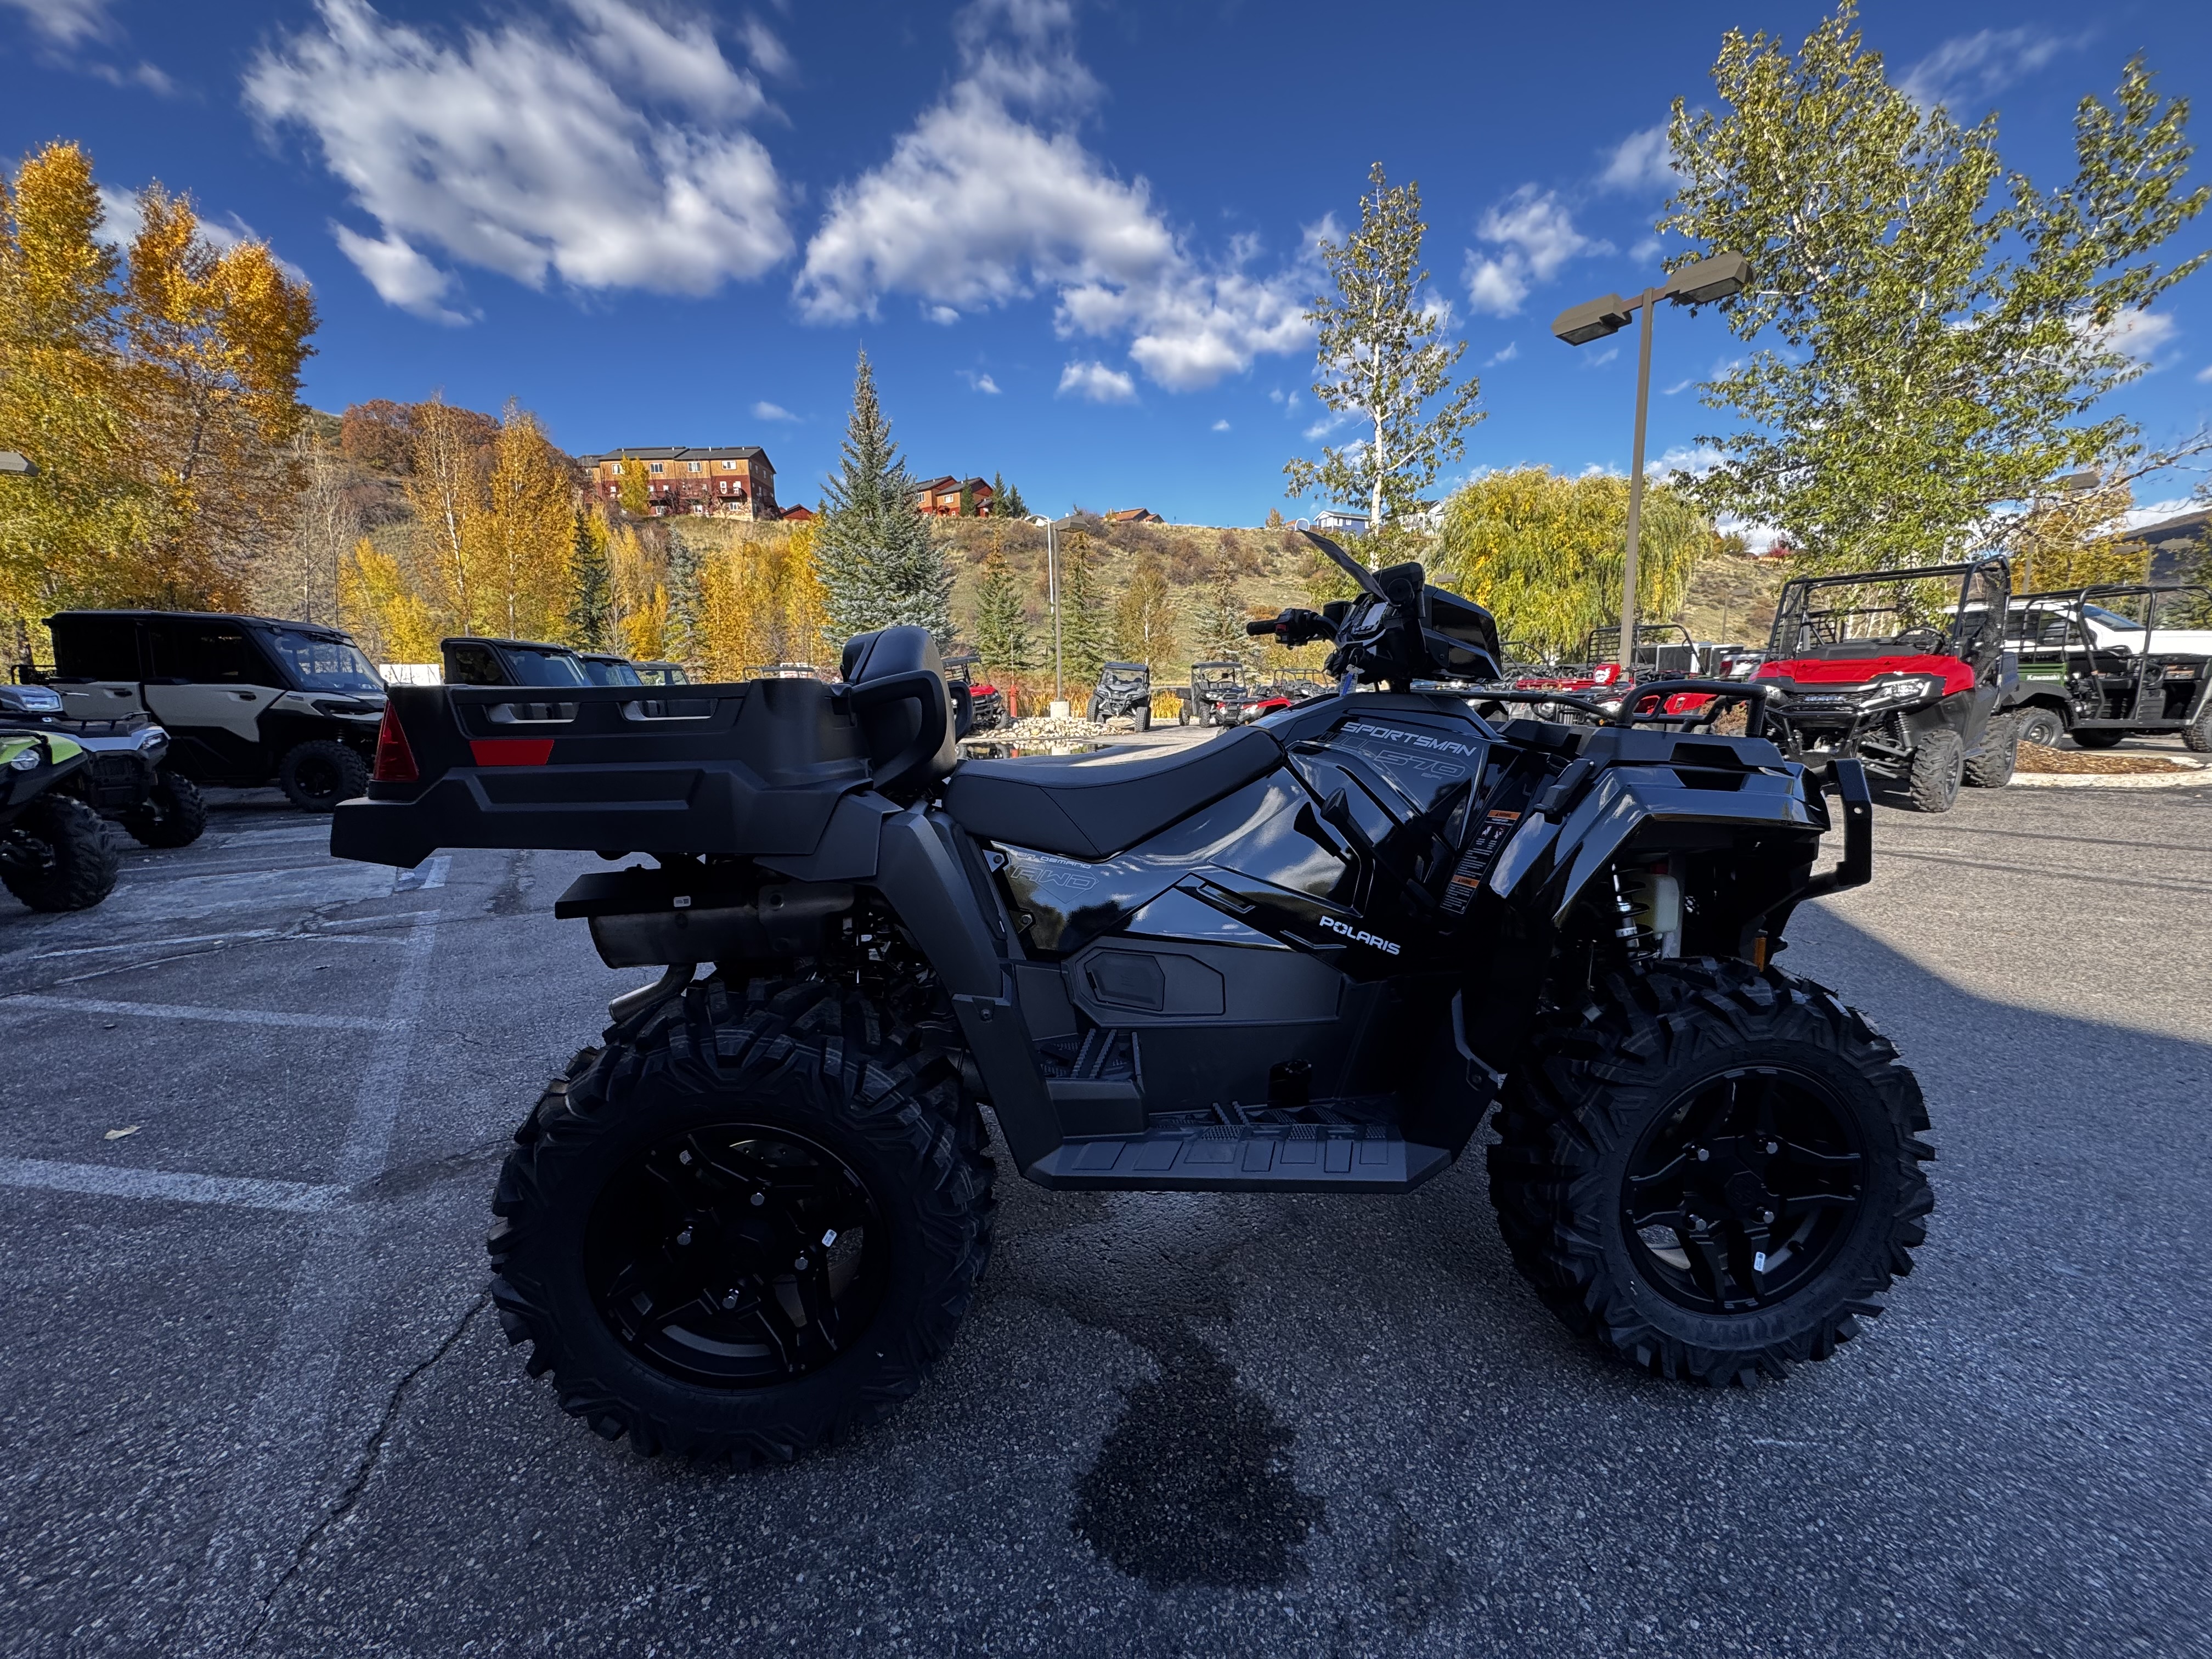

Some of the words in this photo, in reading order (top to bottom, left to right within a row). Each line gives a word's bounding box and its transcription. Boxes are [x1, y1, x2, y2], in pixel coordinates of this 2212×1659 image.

[1340, 721, 1477, 757] SPORTSMAN
[1373, 749, 1465, 777] 570
[1010, 865, 1097, 890] AWD
[1319, 916, 1401, 955] POLARIS
